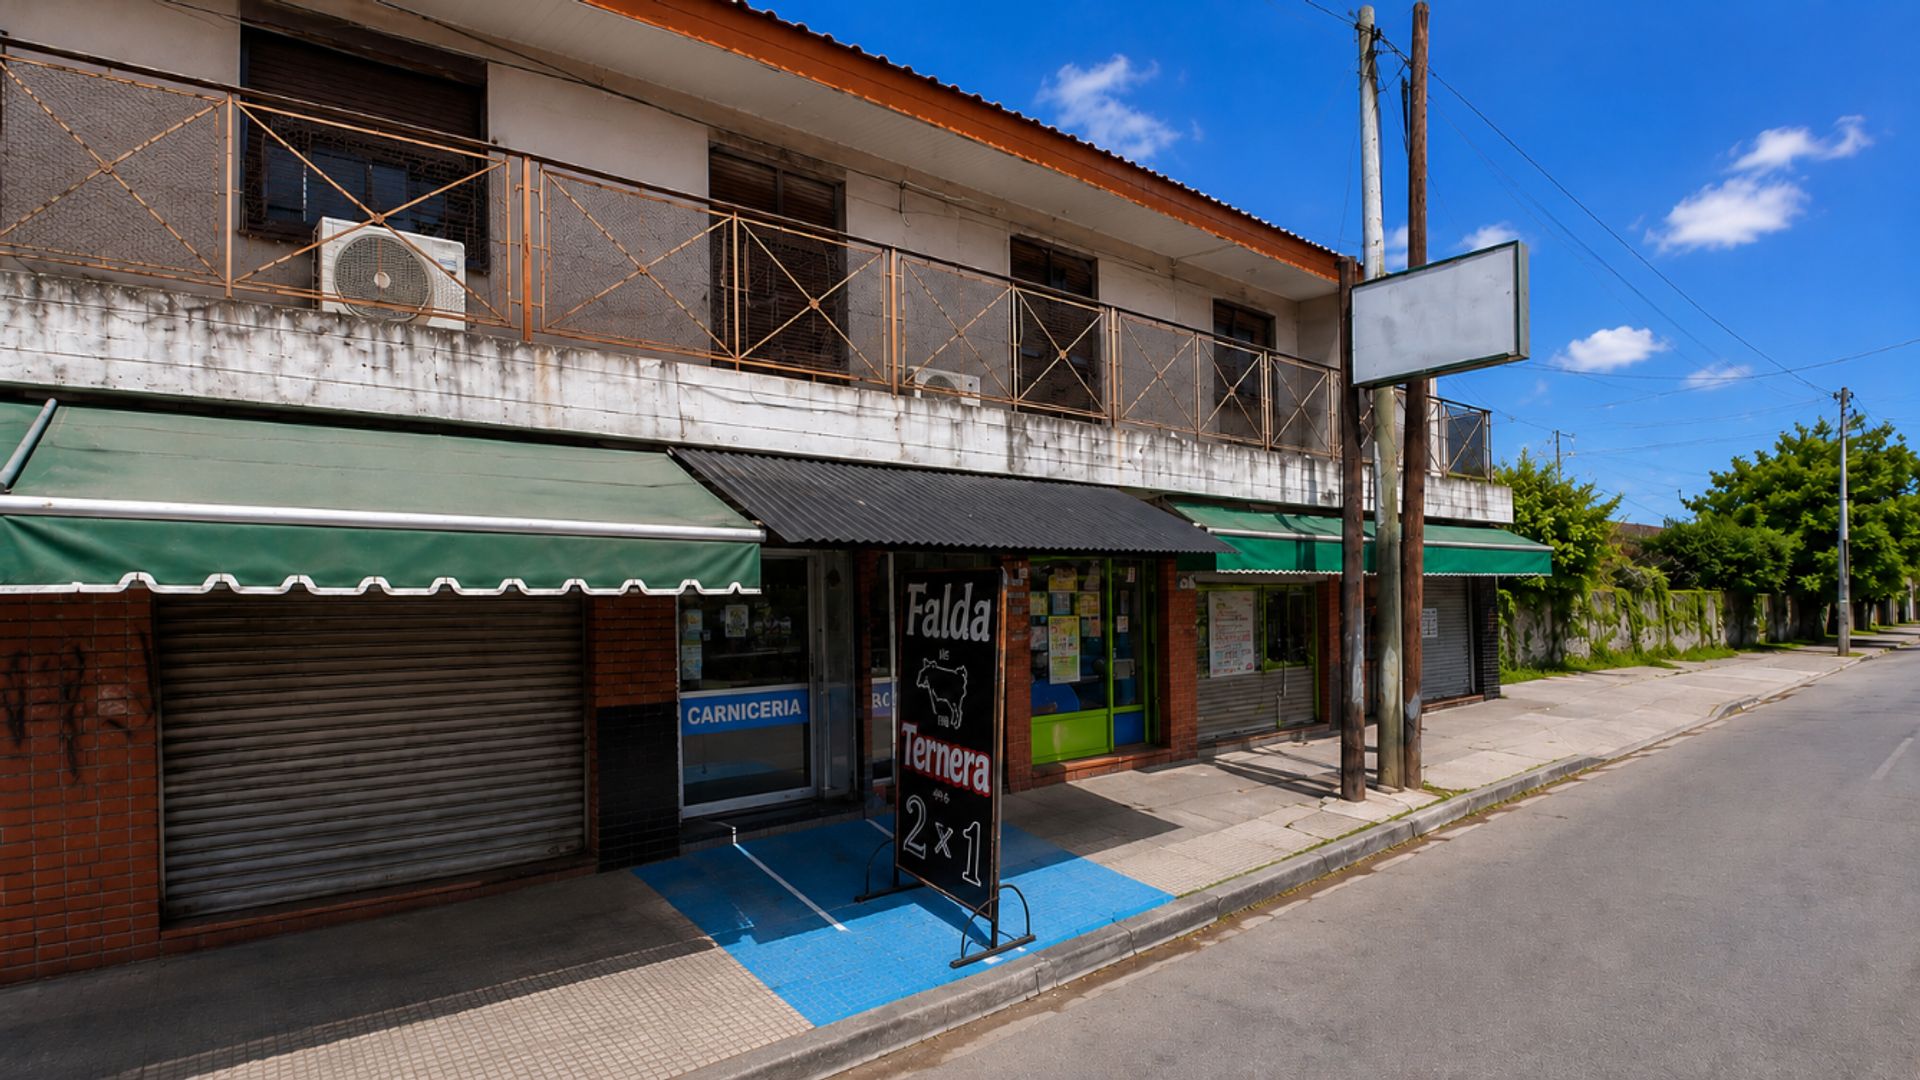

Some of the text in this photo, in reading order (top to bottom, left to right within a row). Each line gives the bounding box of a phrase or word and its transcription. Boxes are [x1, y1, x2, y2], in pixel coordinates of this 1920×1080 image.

[906, 582, 991, 642] Falda
[687, 698, 801, 725] CARNICERIA
[901, 722, 990, 794] Ternera
[903, 794, 927, 860] 2
[962, 821, 981, 887] 1
